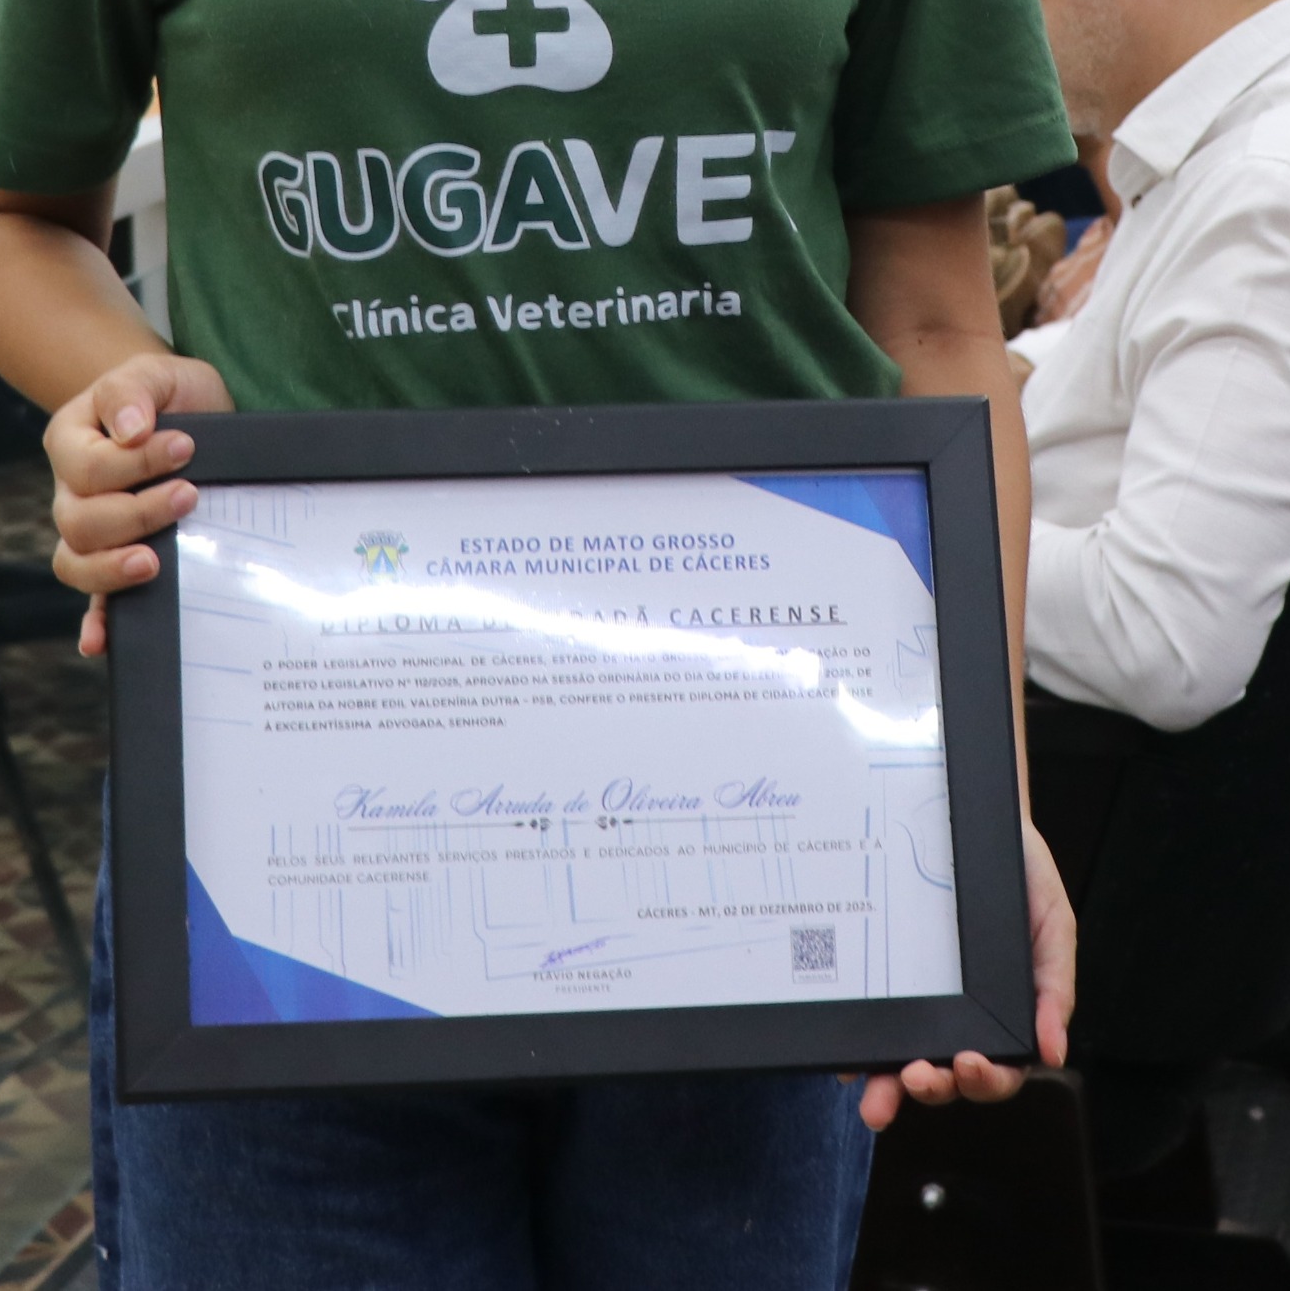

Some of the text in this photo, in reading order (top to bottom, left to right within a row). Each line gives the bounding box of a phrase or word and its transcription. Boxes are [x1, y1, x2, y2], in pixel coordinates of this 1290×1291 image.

[487, 282, 742, 331] Veterinaria
[460, 533, 735, 555] ESTADO DE MATO GROSSO
[426, 553, 771, 577] CÂMARA MUNICIPAL DE CÁCERES
[669, 604, 840, 625] CACERENSE
[263, 660, 273, 671] O
[278, 659, 318, 671] PODER
[323, 658, 397, 670] LEGISLATIVO
[402, 656, 466, 668] MUNICIPAL
[470, 655, 486, 667] DE
[552, 652, 597, 665] ESTADO
[853, 647, 871, 658] DO
[263, 680, 318, 691] DECRETO
[321, 678, 394, 690] LEGISLATIVO
[465, 674, 529, 686] APROVADO
[532, 674, 548, 685] NA
[551, 672, 595, 685] SESSÃO
[598, 671, 660, 684] ORDINÁRIA
[664, 672, 681, 682] DO
[685, 672, 703, 682] DIA
[724, 671, 739, 681] DE
[856, 668, 872, 677] DE
[264, 700, 315, 711] AUTORIA
[318, 699, 334, 710] DA
[338, 699, 378, 710] NOBRE
[381, 698, 406, 709] EDIL
[482, 696, 520, 706] DUTRA
[559, 694, 613, 705] CONFERE
[616, 693, 626, 703] O
[629, 692, 685, 703] PRESENTE
[689, 691, 741, 702] DIPLOMA
[743, 690, 758, 701] DE
[807, 687, 872, 699] CACENSE
[275, 718, 372, 732] EXCELENTÍSSIMA
[334, 776, 802, 820] Kamila Arruda de Oliveira Abreu
[267, 856, 307, 867] PELOS
[314, 855, 346, 866] SEUS
[353, 853, 430, 865] RELEVANTES
[438, 850, 498, 864] SERVIÇOS
[505, 847, 576, 861] PRESTADOS
[583, 847, 591, 858] E
[598, 844, 670, 858] DEDICADOS
[677, 844, 696, 856] AO
[703, 841, 767, 855] MUNICÍPIO
[773, 842, 789, 853] DE
[797, 839, 852, 852] CÁCERES
[859, 839, 867, 850] E
[267, 872, 353, 886] COMUNIDADE
[637, 905, 688, 919] CÁCERES
[698, 907, 720, 919] MT,
[724, 906, 738, 917] 02
[741, 905, 757, 916] DE
[760, 903, 823, 916] DEZEMBRO
[827, 902, 842, 914] DE
[578, 967, 633, 981] NEGAÇÃO
[555, 984, 611, 994] PRESIDENTE
